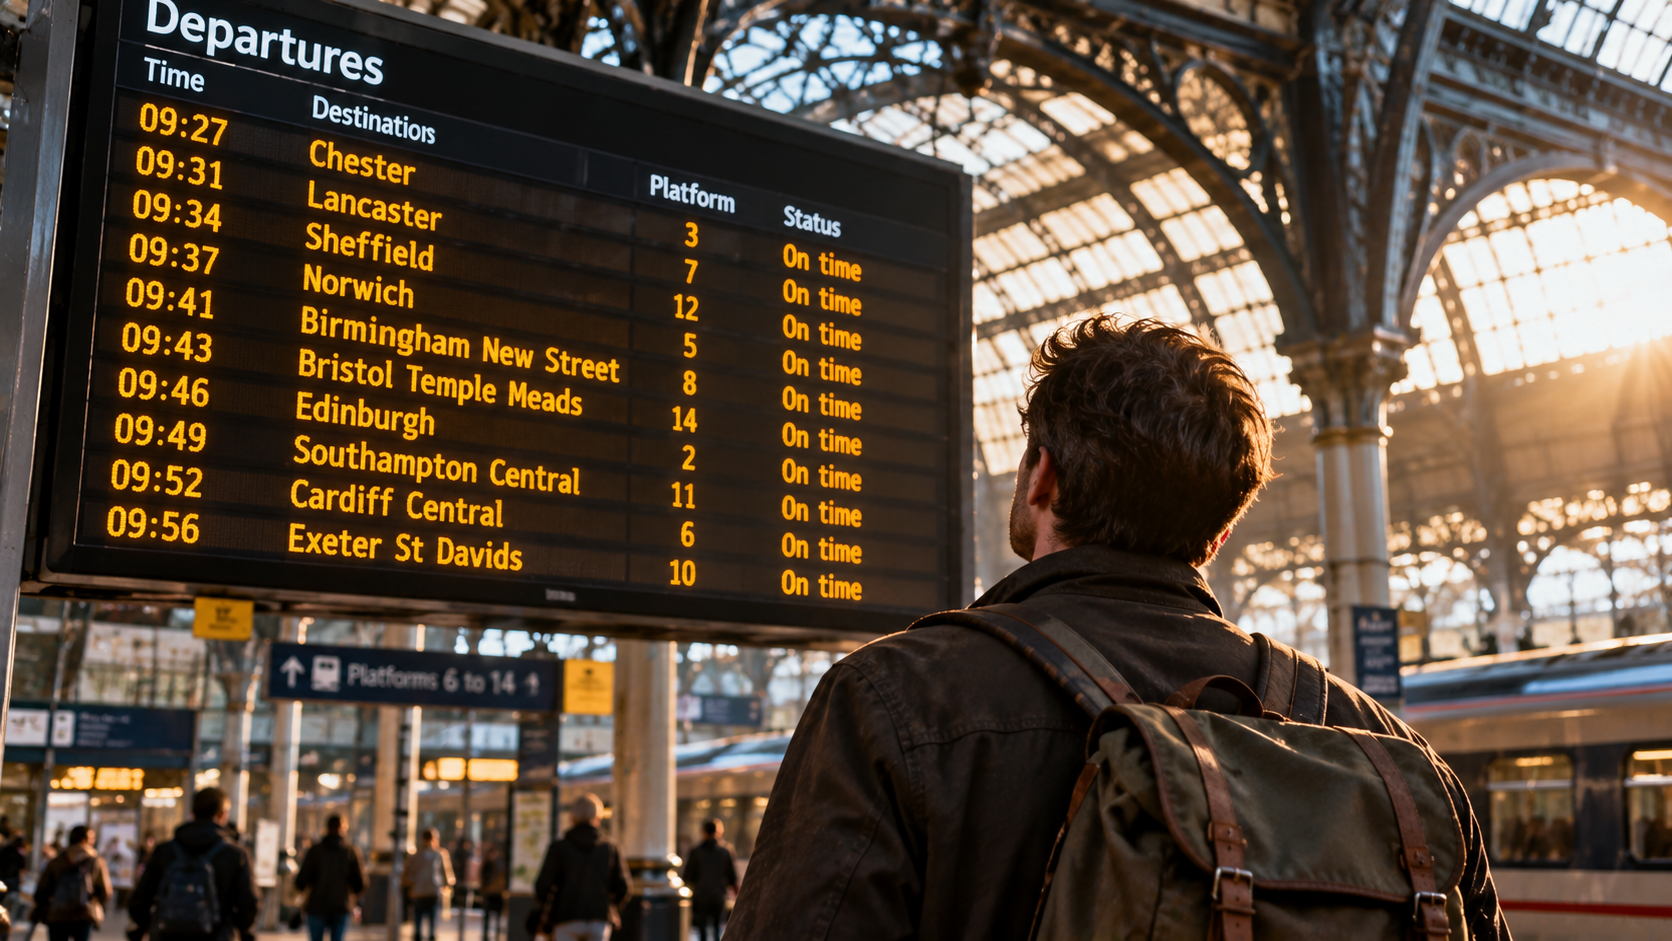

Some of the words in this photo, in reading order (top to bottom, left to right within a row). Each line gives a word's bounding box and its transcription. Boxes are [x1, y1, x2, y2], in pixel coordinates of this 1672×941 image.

[146, 0, 384, 85] Departures
[139, 102, 228, 146] 09:27
[309, 139, 417, 186] Chester
[684, 221, 699, 248] 3
[782, 243, 810, 271] On
[818, 251, 862, 282] time
[143, 56, 205, 93] Time
[650, 174, 735, 214] Platform
[783, 205, 841, 238] Status
[132, 189, 222, 233] 09:34
[305, 221, 434, 272] Sheffield
[673, 293, 699, 322] 12
[782, 313, 810, 342] On
[818, 321, 862, 352] time
[135, 145, 223, 191] 09:31
[307, 179, 443, 232] Lancaster
[684, 258, 699, 284] 7
[782, 278, 810, 306] On
[818, 286, 862, 317] time
[125, 277, 214, 320] 09:41
[300, 305, 470, 359] Birmingham
[482, 335, 535, 369] New
[544, 346, 620, 384] Street
[682, 369, 697, 396] 8
[782, 385, 810, 414] On
[818, 392, 862, 421] time
[129, 232, 220, 275] 09:37
[303, 263, 414, 309] Norwich
[683, 332, 698, 359] 5
[782, 349, 810, 377] On
[818, 356, 862, 386] time
[118, 367, 210, 408] 09:46
[296, 390, 435, 441] Edinburgh
[681, 444, 696, 471] 2
[781, 457, 809, 485] On
[818, 463, 862, 492] time
[121, 321, 213, 363] 09:43
[298, 348, 394, 389] Bristol
[406, 364, 497, 406] Temple
[508, 380, 583, 417] Meads
[671, 405, 698, 433] 14
[781, 421, 809, 449] On
[818, 428, 863, 457] time
[110, 458, 203, 499] 09:52
[290, 478, 395, 517] Cardiff
[406, 490, 504, 528] Central
[680, 520, 695, 548] 6
[781, 532, 809, 560] On
[818, 536, 863, 565] time
[114, 412, 207, 453] 09:49
[293, 434, 478, 484] Southampton
[489, 458, 581, 496] Central
[671, 481, 696, 510] 11
[781, 494, 809, 522] On
[818, 499, 863, 528] time
[106, 505, 200, 544] 09:56
[288, 522, 383, 559] Exeter
[394, 532, 424, 563] St
[436, 536, 523, 572] Davids
[669, 559, 697, 587] 10
[781, 569, 809, 596] On
[817, 573, 863, 601] time
[347, 662, 440, 691] Platforms
[443, 667, 459, 693] 6
[464, 671, 486, 694] to
[490, 670, 516, 695] 14
